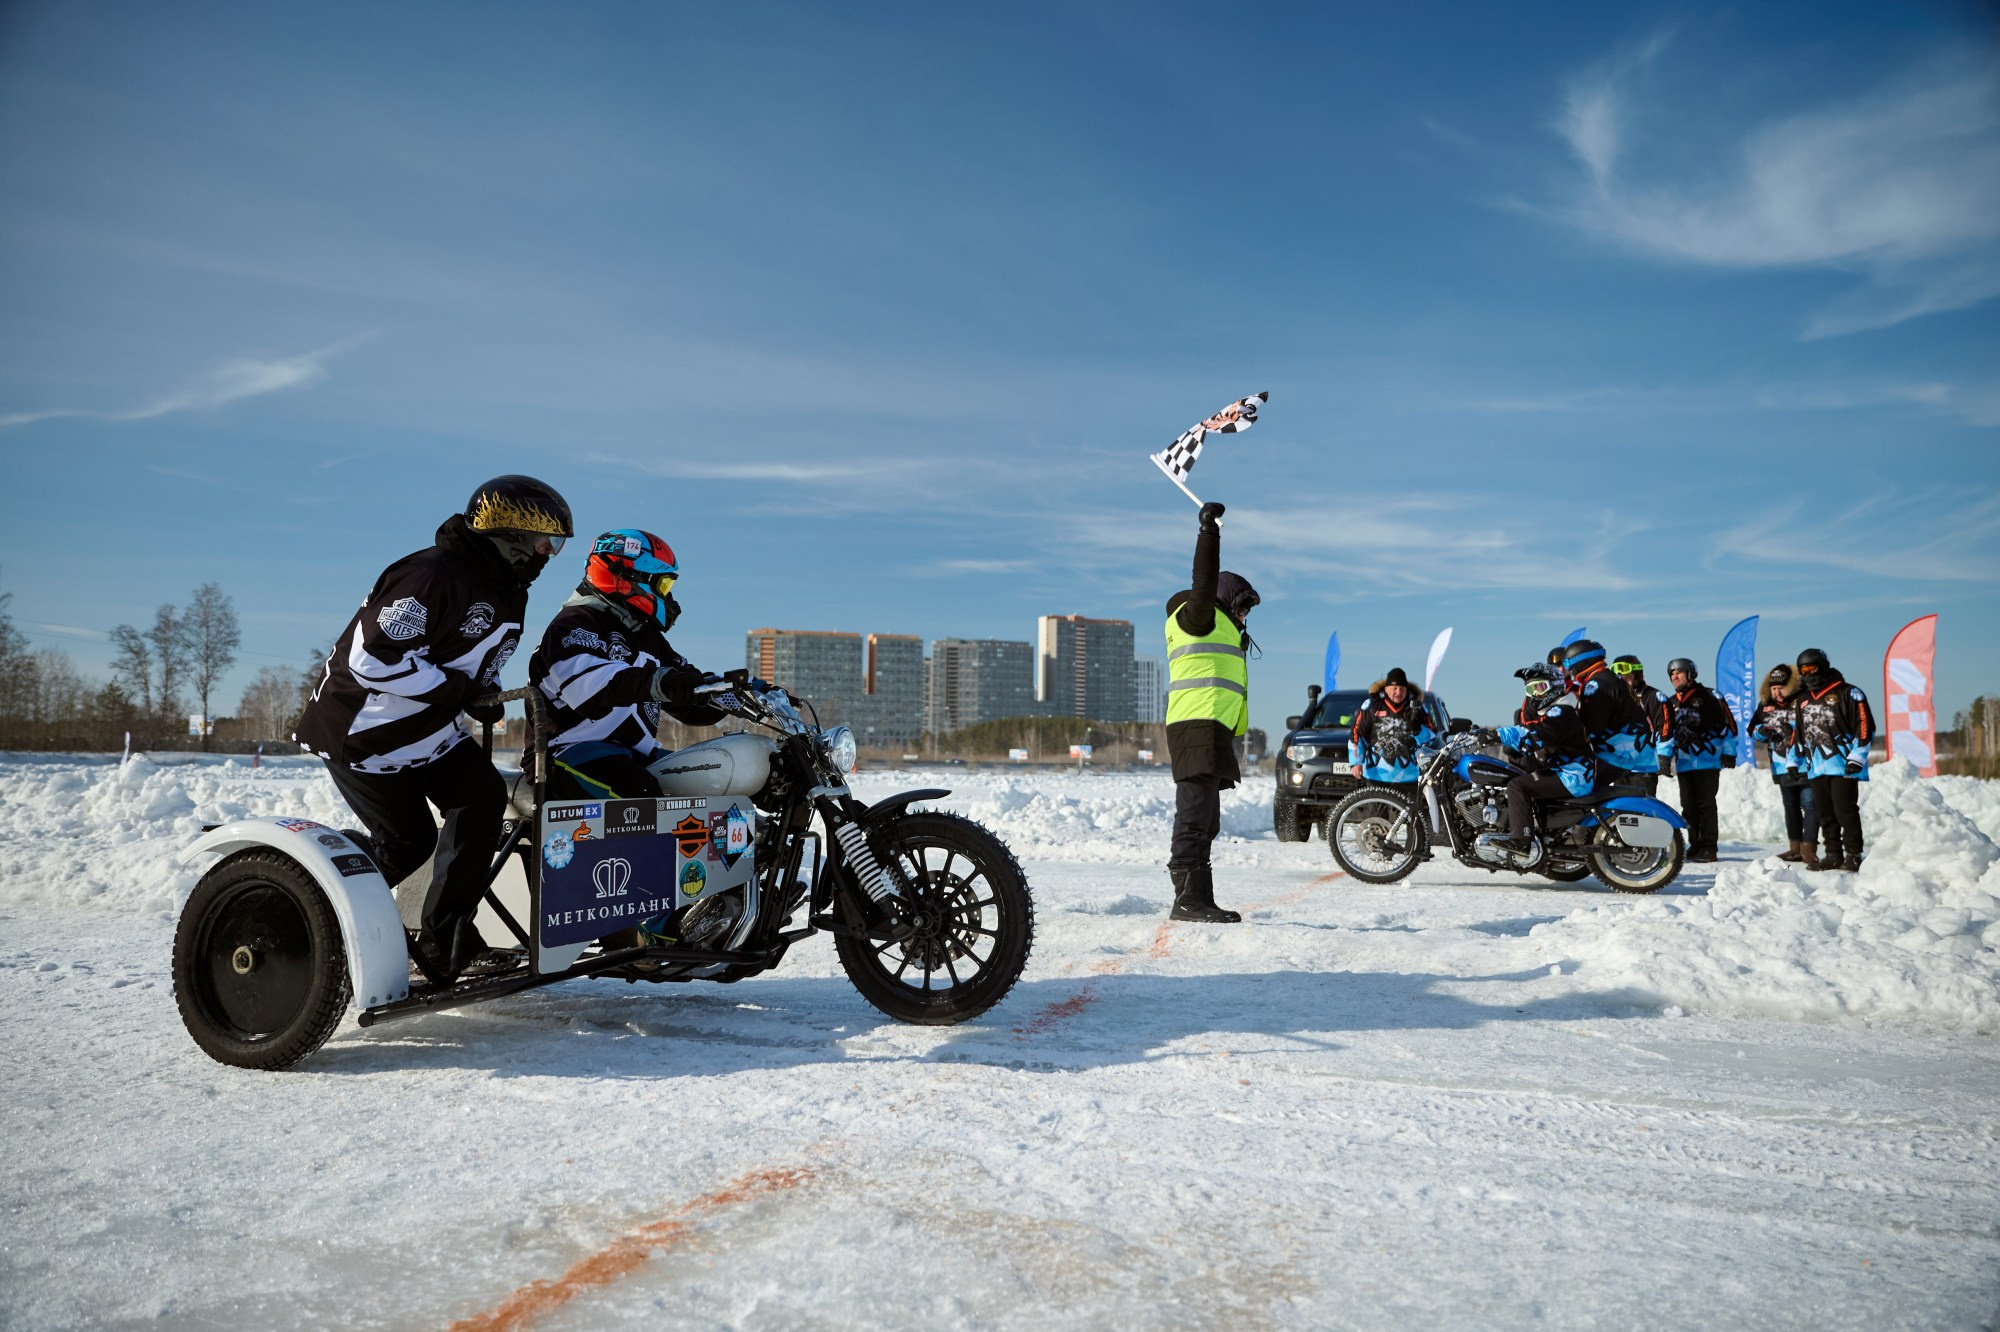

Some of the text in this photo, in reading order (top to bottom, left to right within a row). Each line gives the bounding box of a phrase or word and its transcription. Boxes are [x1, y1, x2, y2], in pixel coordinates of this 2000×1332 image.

[627, 542, 639, 550] 174
[385, 621, 413, 636] CYCLES
[550, 806, 598, 819] BITUMEX
[606, 824, 656, 834] МЕТКОМБАНК
[731, 828, 743, 842] 66
[547, 897, 671, 927] МЕТКОМБАНК
